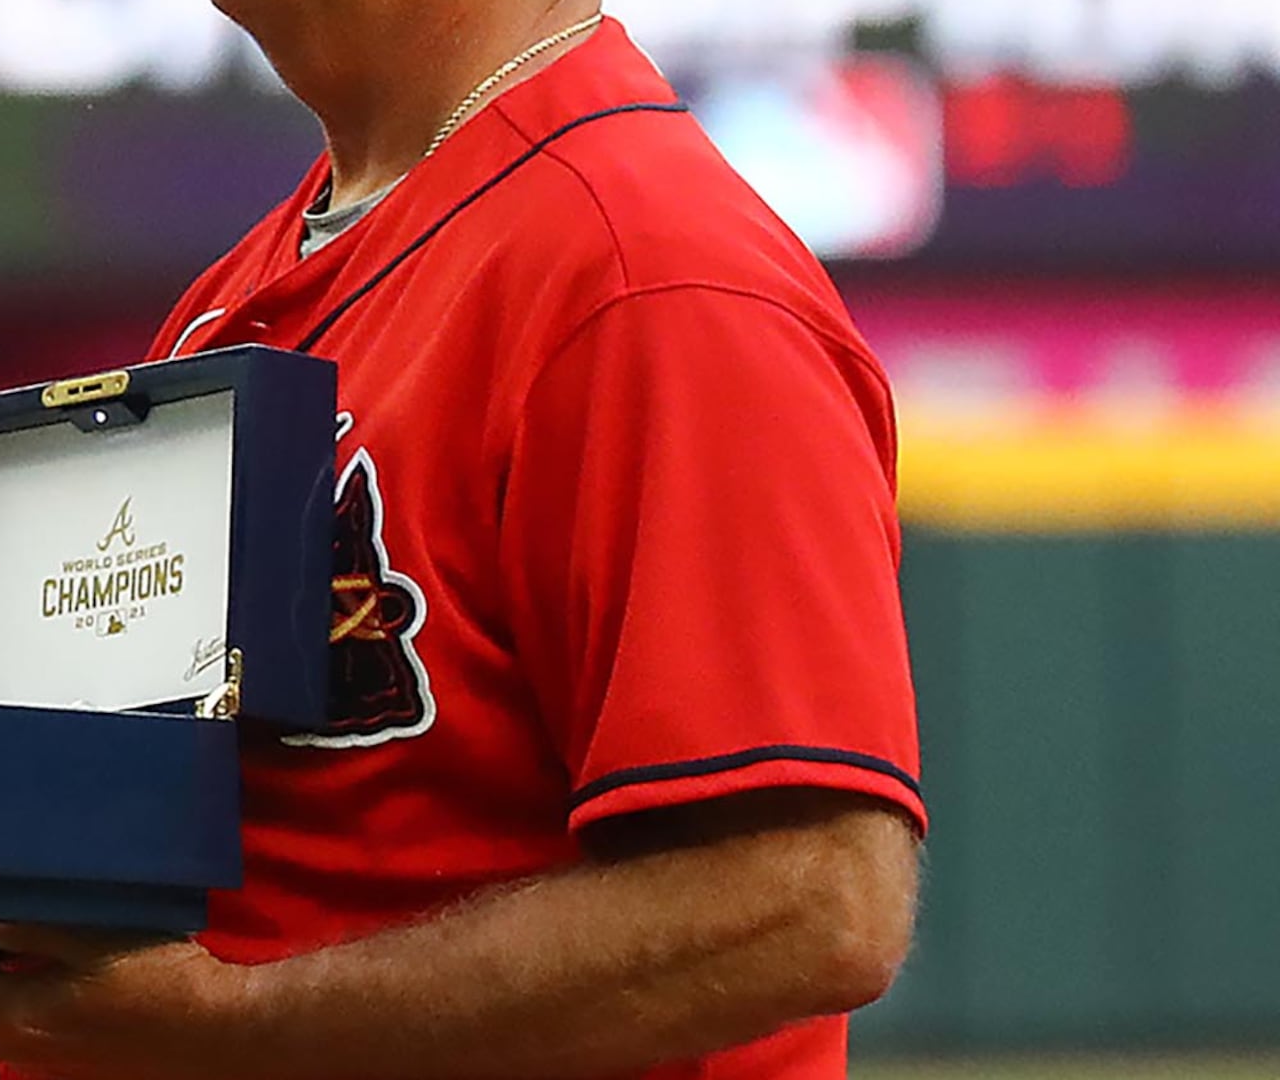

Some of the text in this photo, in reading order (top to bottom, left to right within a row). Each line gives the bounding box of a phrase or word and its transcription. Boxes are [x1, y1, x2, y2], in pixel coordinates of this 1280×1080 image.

[97, 496, 135, 551] A
[62, 541, 167, 574] WORLD SERIES
[42, 554, 184, 617] CHAMPIONS
[75, 605, 146, 629] 20 21
